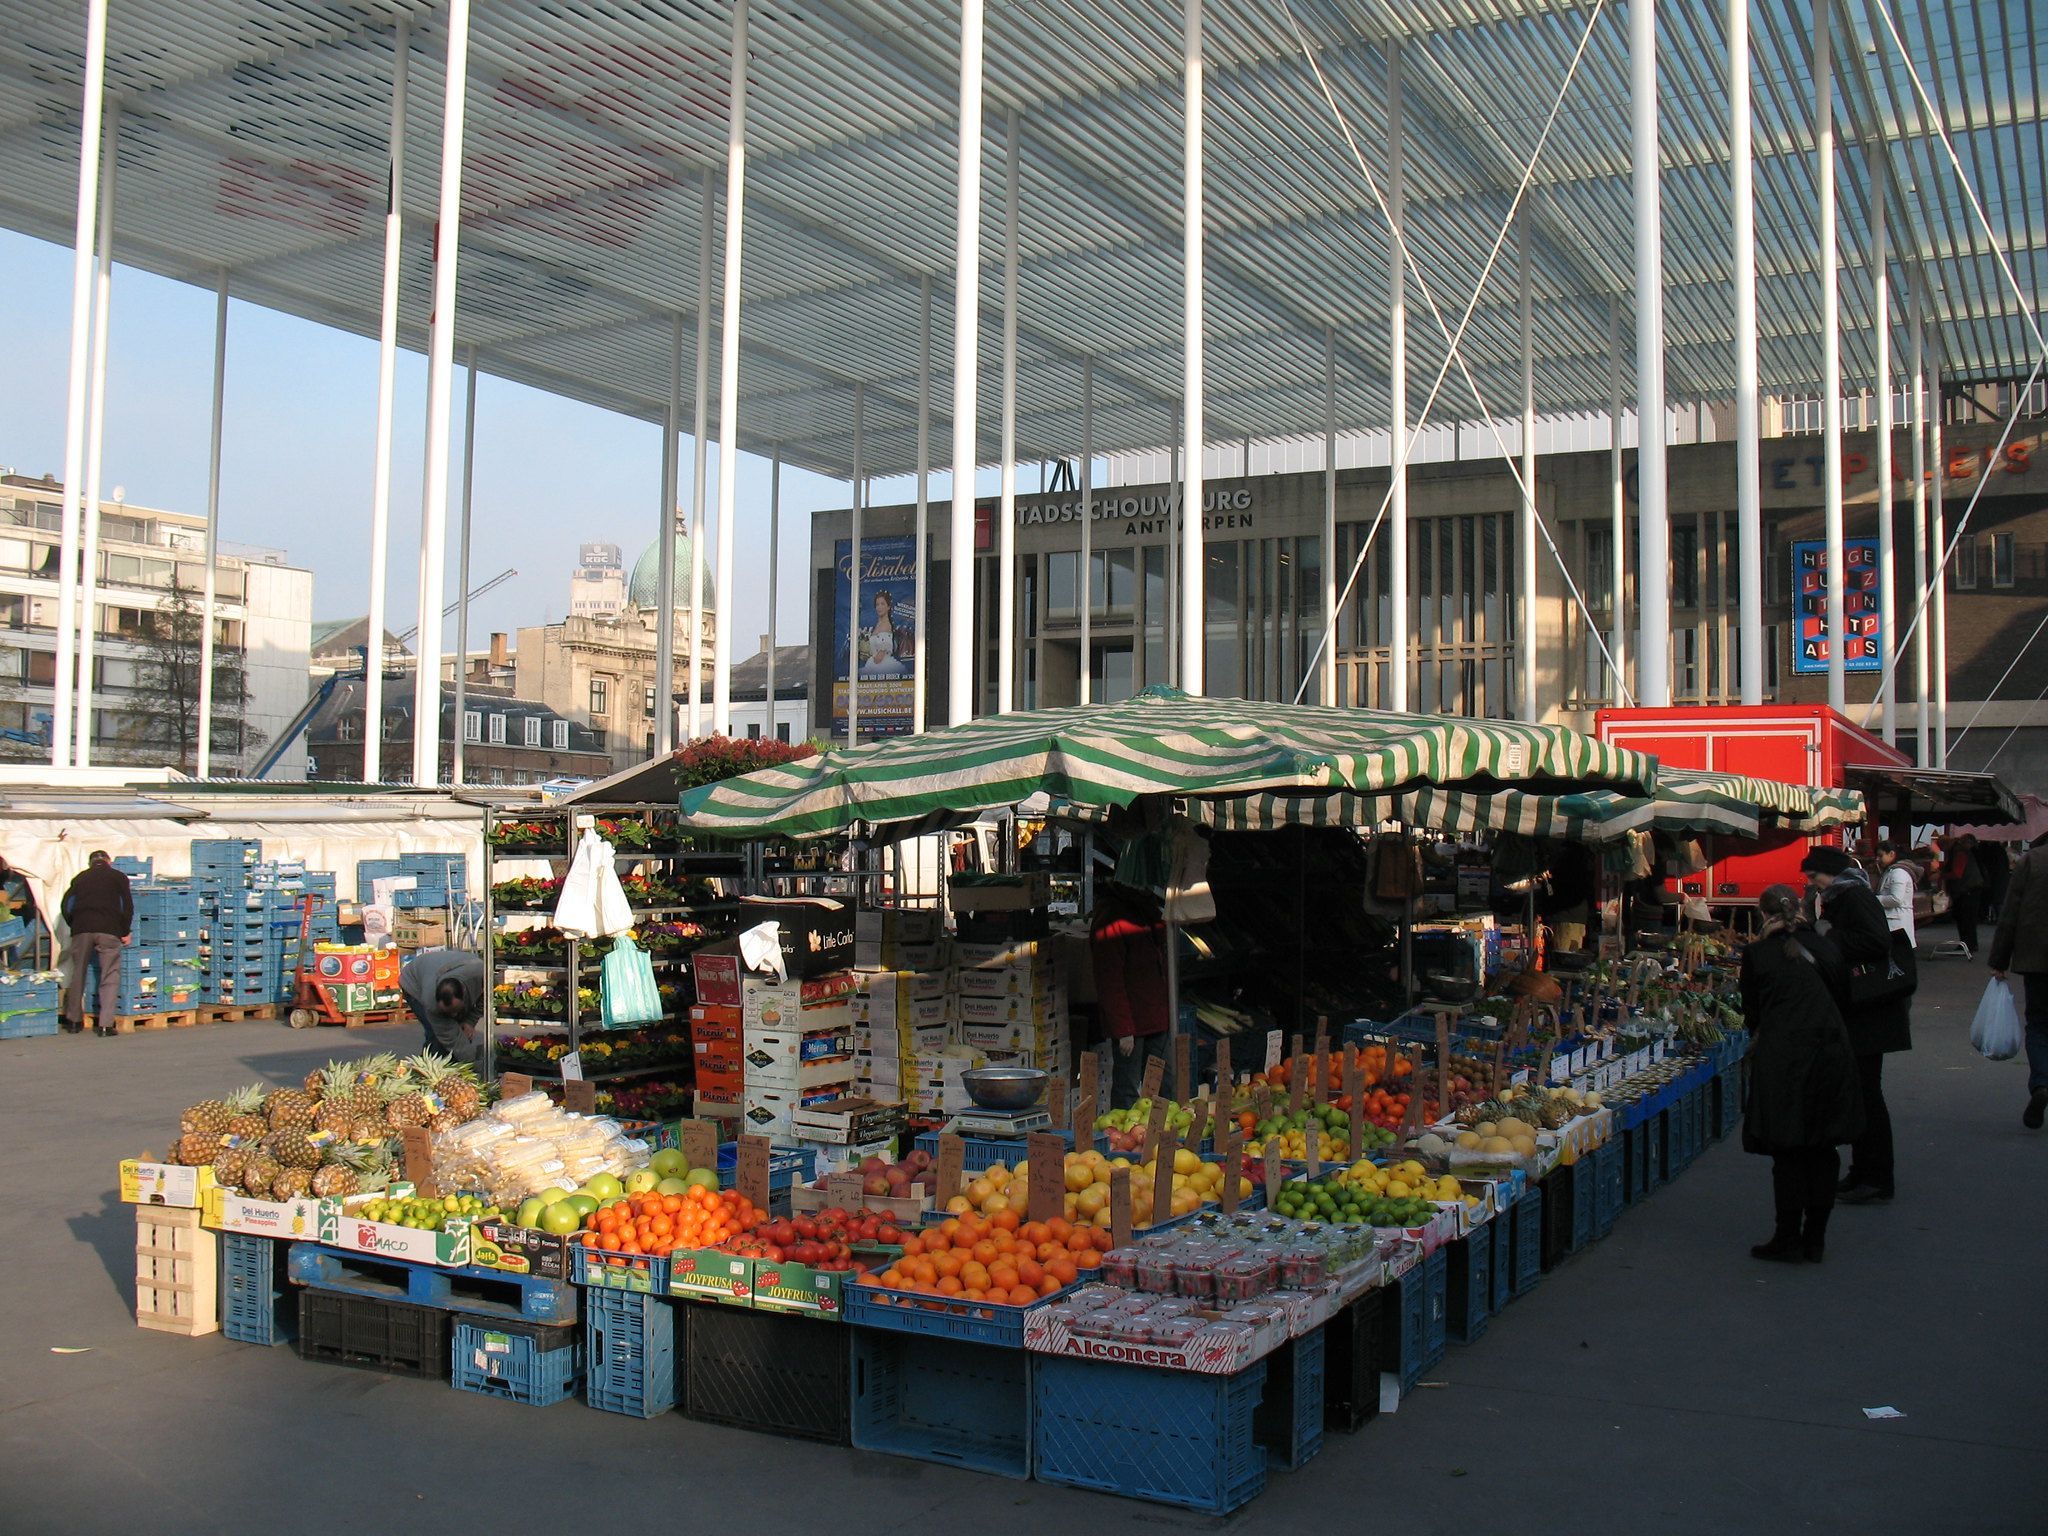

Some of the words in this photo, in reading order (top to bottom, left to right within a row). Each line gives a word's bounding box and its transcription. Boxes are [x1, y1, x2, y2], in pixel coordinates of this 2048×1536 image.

[1013, 488, 1252, 526] TADSSCHOUWURG
[823, 932, 837, 949] Little
[978, 1032, 999, 1040] Huerto
[904, 1059, 913, 1067] Del
[914, 1059, 934, 1067] Huerto
[904, 1087, 913, 1095] Del
[914, 1087, 934, 1096] Huerto
[122, 1165, 133, 1175] Del
[134, 1166, 155, 1176] Huerto
[241, 1206, 253, 1215] Del
[254, 1207, 280, 1219] Huerto
[244, 1216, 277, 1227] Pineapples
[684, 1272, 733, 1290] JOYFRUSA
[768, 1285, 819, 1304] JOYFRUSA
[1063, 1337, 1188, 1368] Alconera
